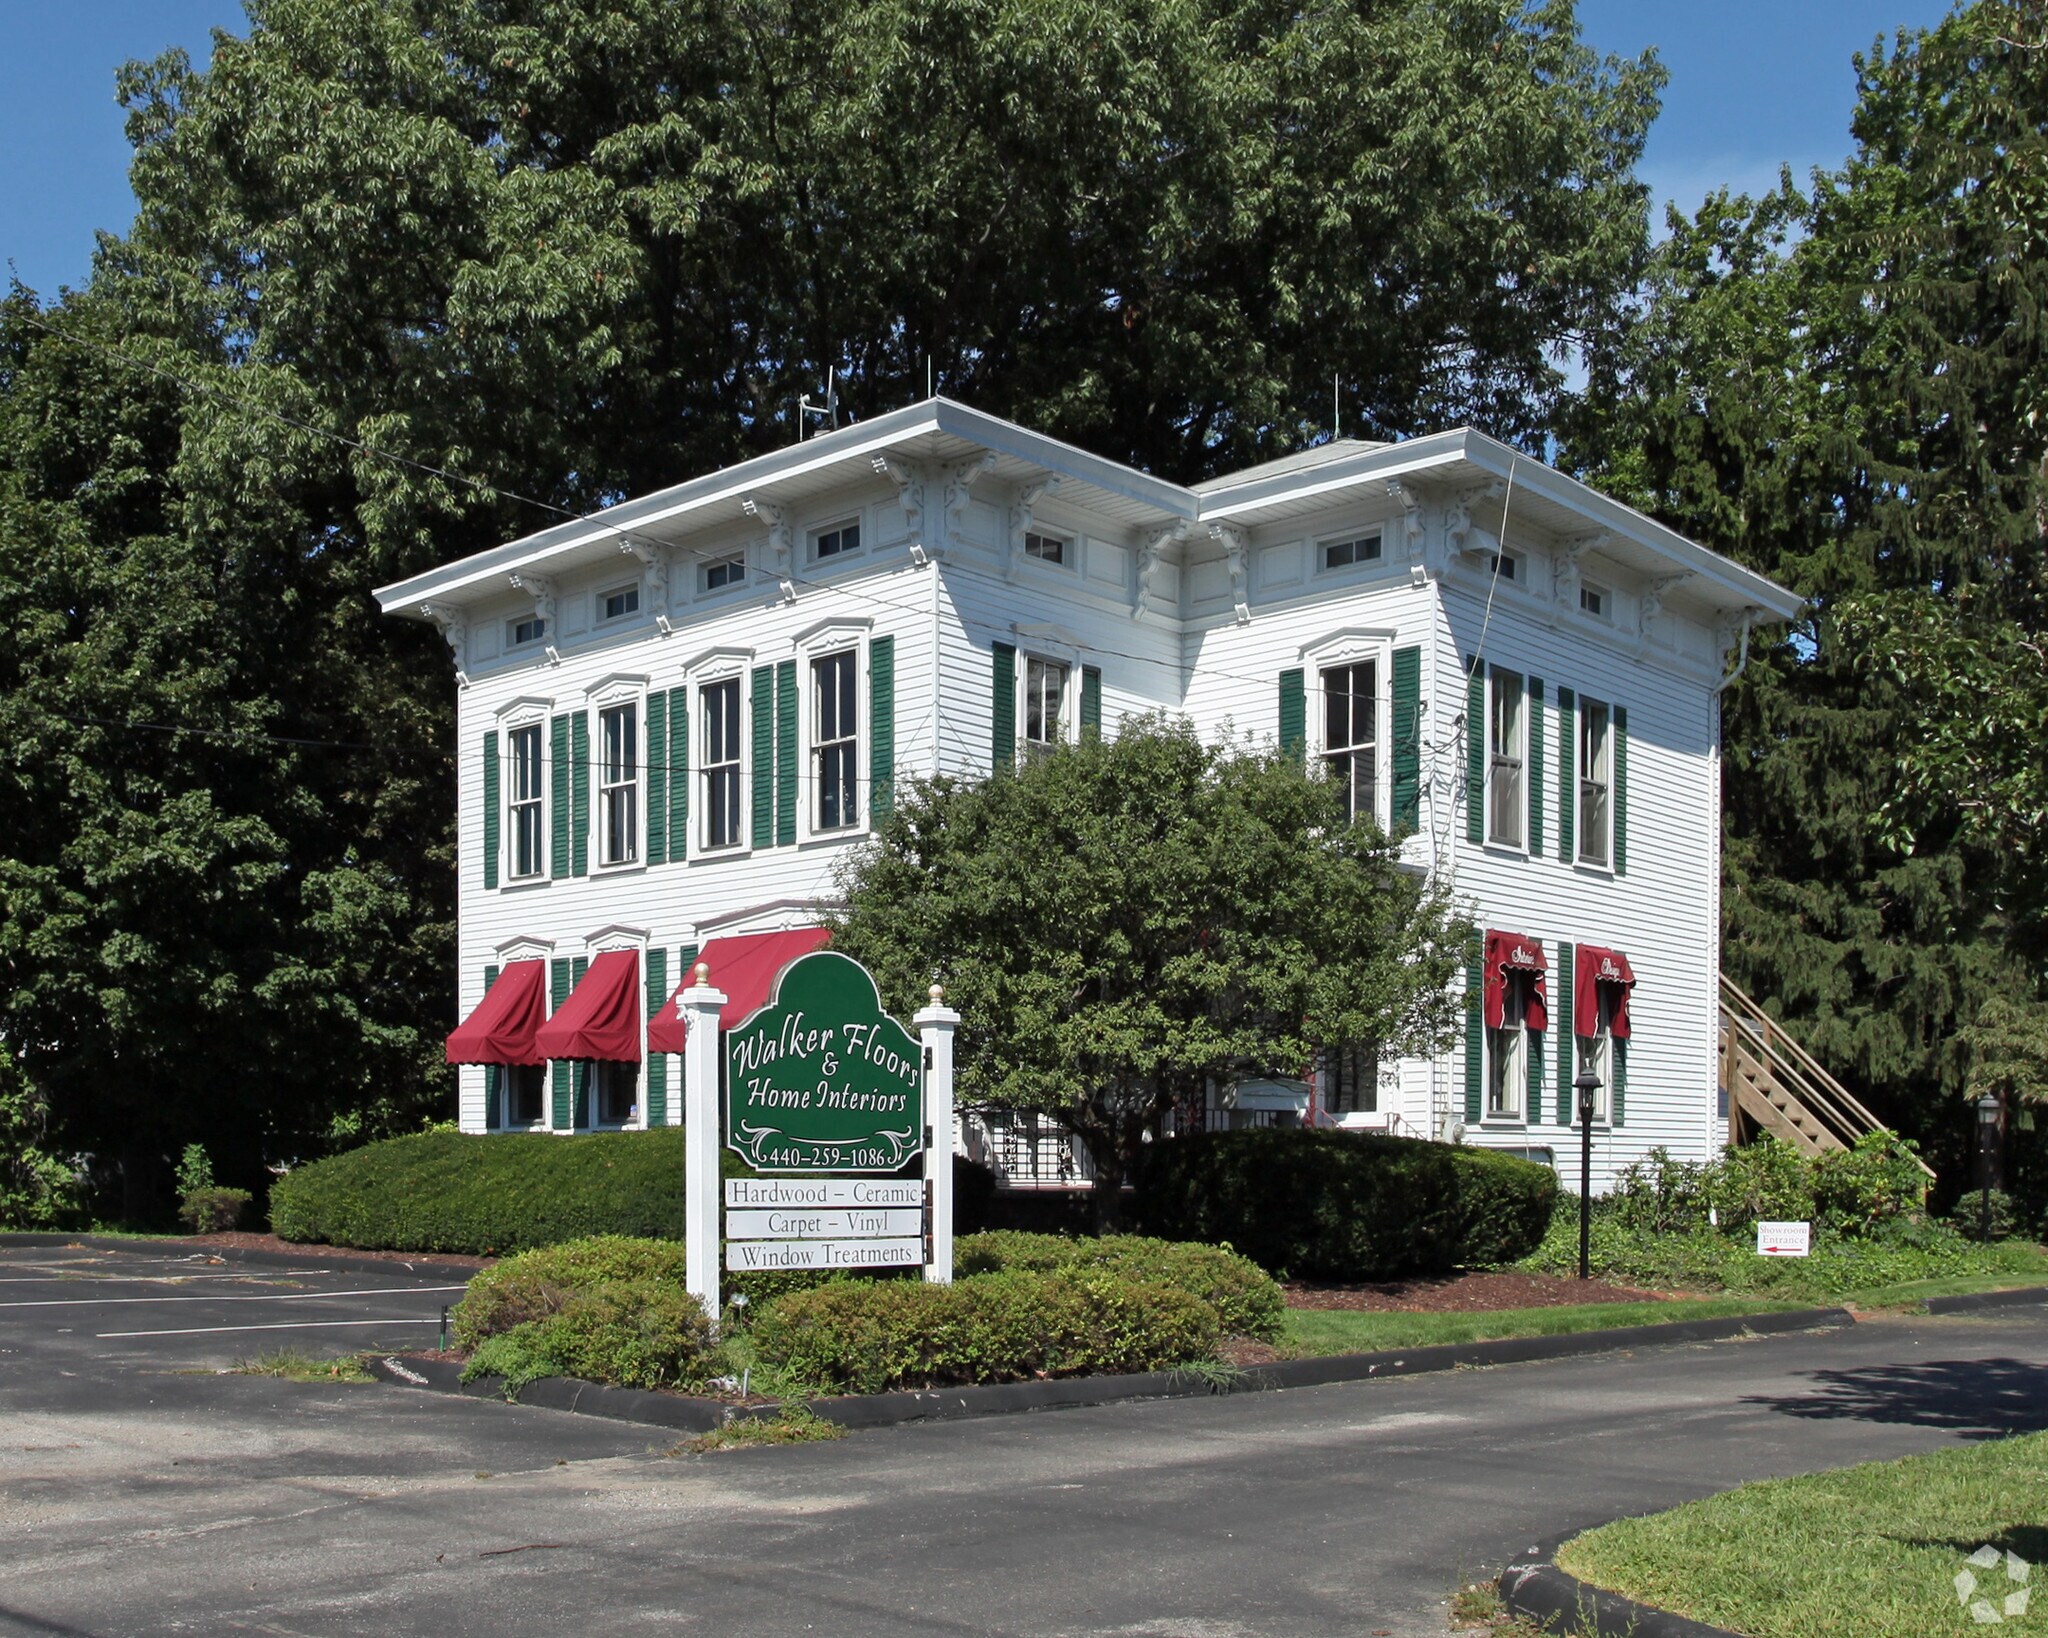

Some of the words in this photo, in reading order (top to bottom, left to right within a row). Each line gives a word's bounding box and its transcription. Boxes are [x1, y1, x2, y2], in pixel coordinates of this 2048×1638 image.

[732, 1011, 834, 1078] Walker
[842, 1023, 919, 1088] Floors
[821, 1051, 839, 1076] &
[747, 1077, 810, 1109] Home
[815, 1080, 907, 1112] Interiors
[769, 1147, 886, 1167] 440-259-1086
[732, 1182, 828, 1203] Hardwood
[852, 1182, 918, 1202] Ceramic
[768, 1213, 822, 1237] Carpet
[846, 1211, 889, 1235] Vinyl
[1759, 1225, 1807, 1234] Showroom
[1762, 1235, 1805, 1244] Entrance
[741, 1245, 814, 1267] Window
[821, 1243, 913, 1264] Treatments
